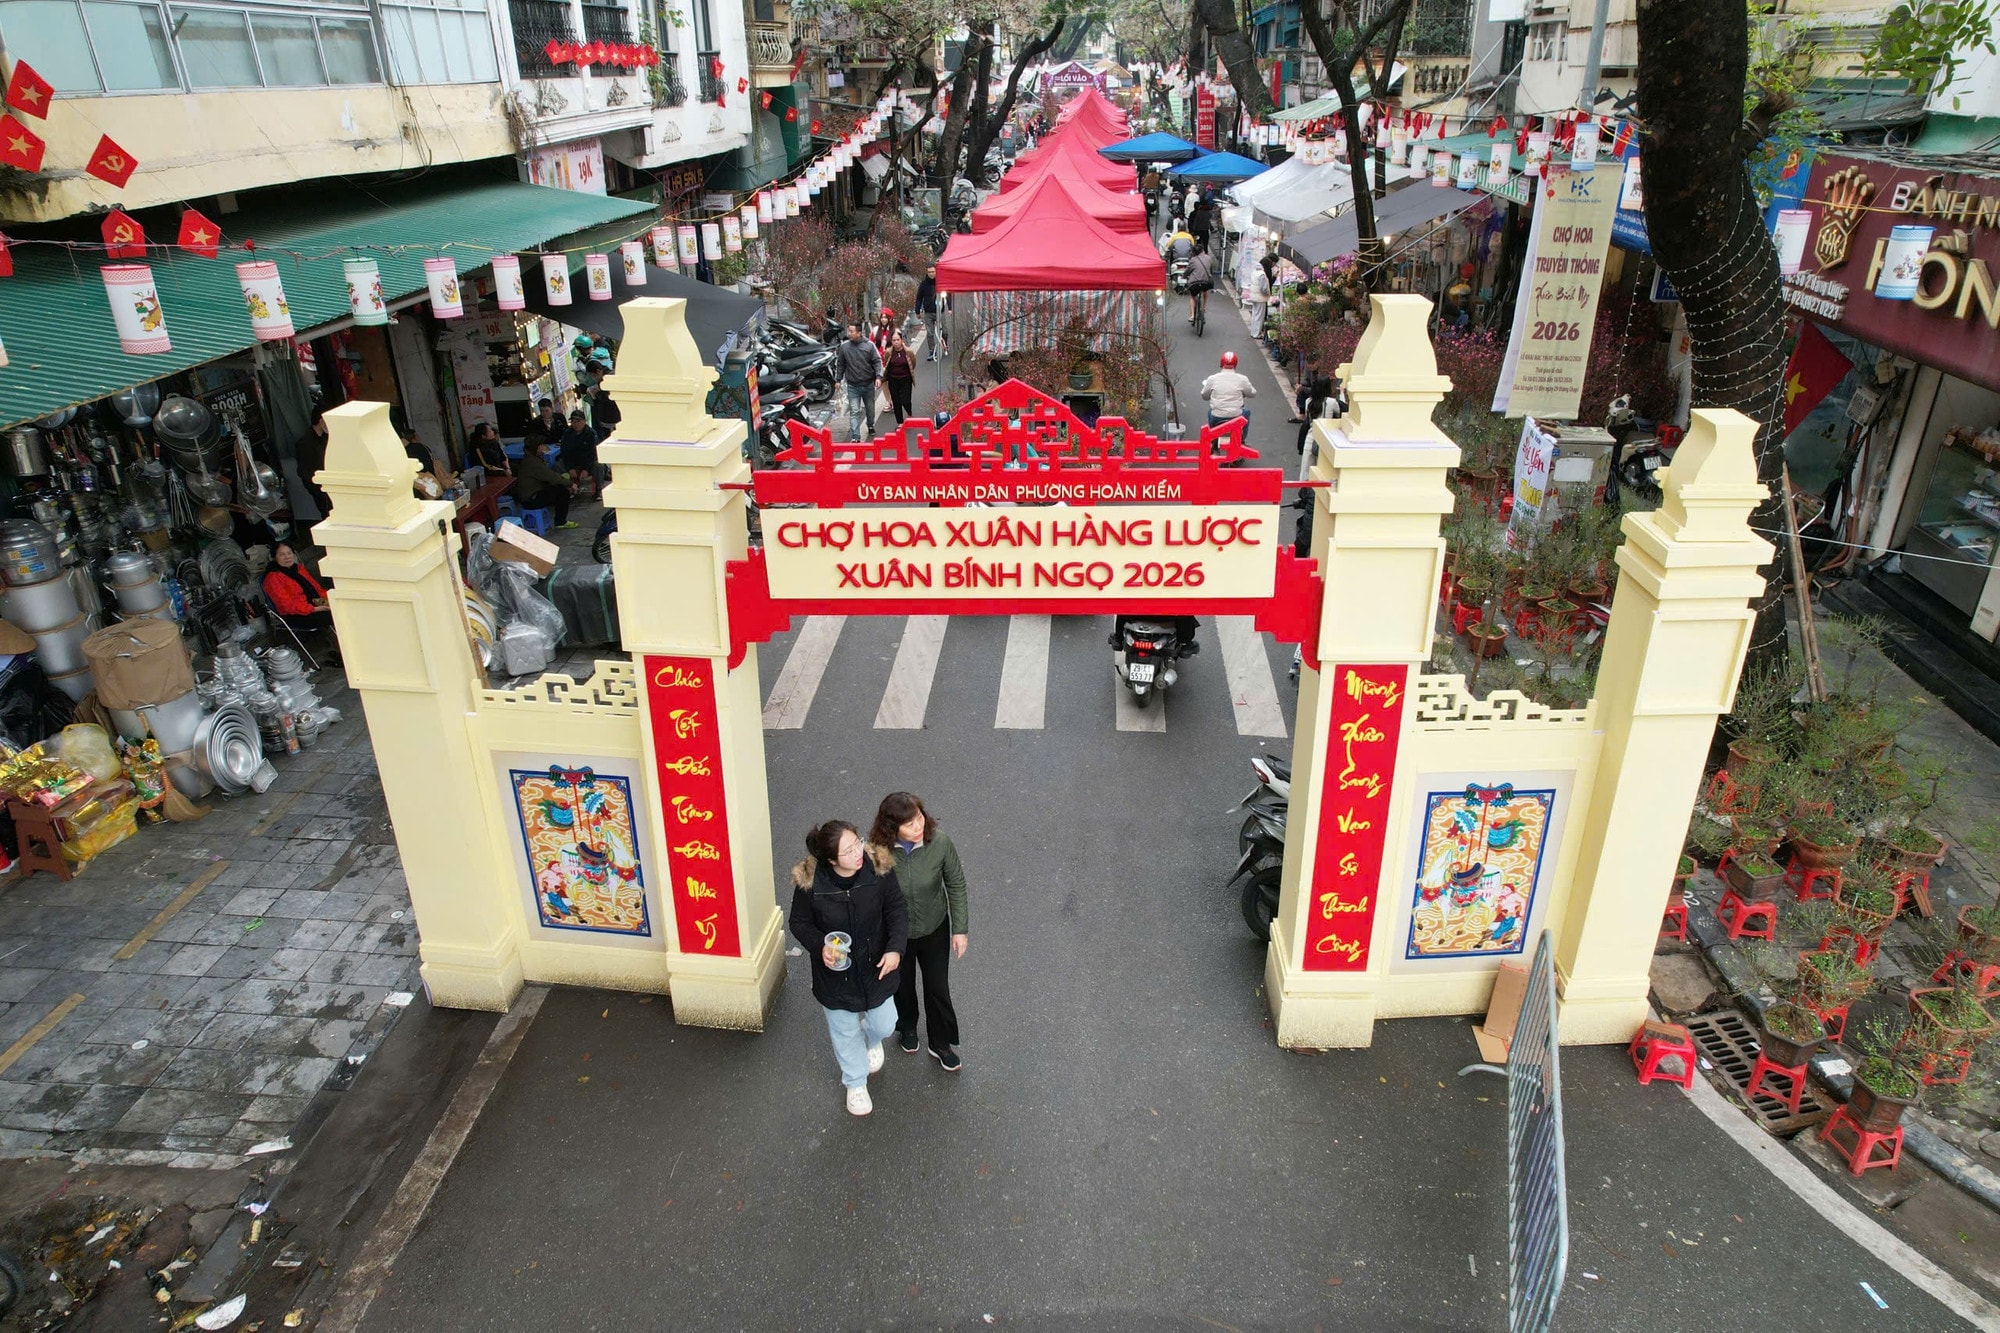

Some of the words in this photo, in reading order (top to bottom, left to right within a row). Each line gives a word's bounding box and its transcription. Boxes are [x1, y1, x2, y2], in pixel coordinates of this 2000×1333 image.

[578, 155, 592, 184] 19K
[1553, 225, 1573, 246] CHỢ
[1573, 227, 1594, 244] HOA
[1570, 252, 1600, 274] THỐNG
[486, 321, 502, 336] 19K
[1532, 321, 1580, 340] 2026
[460, 396, 484, 408] Tặng
[483, 388, 493, 404] 1
[858, 483, 880, 500] ỦY
[884, 486, 916, 500] BAN
[923, 484, 969, 500] NHÂN
[974, 484, 1008, 499] DÂN
[1016, 484, 1085, 499] PHƯỜNG
[1090, 482, 1136, 498] HOÀN
[1143, 479, 1181, 498] KIẾM
[777, 518, 856, 552] CHỢ
[862, 521, 937, 548] HOA
[946, 515, 1041, 548] XUÂN
[1051, 514, 1153, 548] HÀNG
[1164, 515, 1264, 553] LƯỢC
[837, 556, 934, 588] XUÂN
[944, 556, 1022, 588] BÍNH
[1034, 562, 1113, 593] NGỌ
[1123, 561, 1206, 588] 2026
[655, 666, 704, 688] Chúc
[669, 709, 703, 739] Tết
[1340, 714, 1384, 745] Xuân
[665, 756, 711, 776] Đến
[1337, 806, 1371, 834] Vạn
[1339, 852, 1359, 876] Sự
[1320, 892, 1368, 920] Thành
[694, 914, 718, 950] Ý
[1316, 934, 1368, 962] Công
